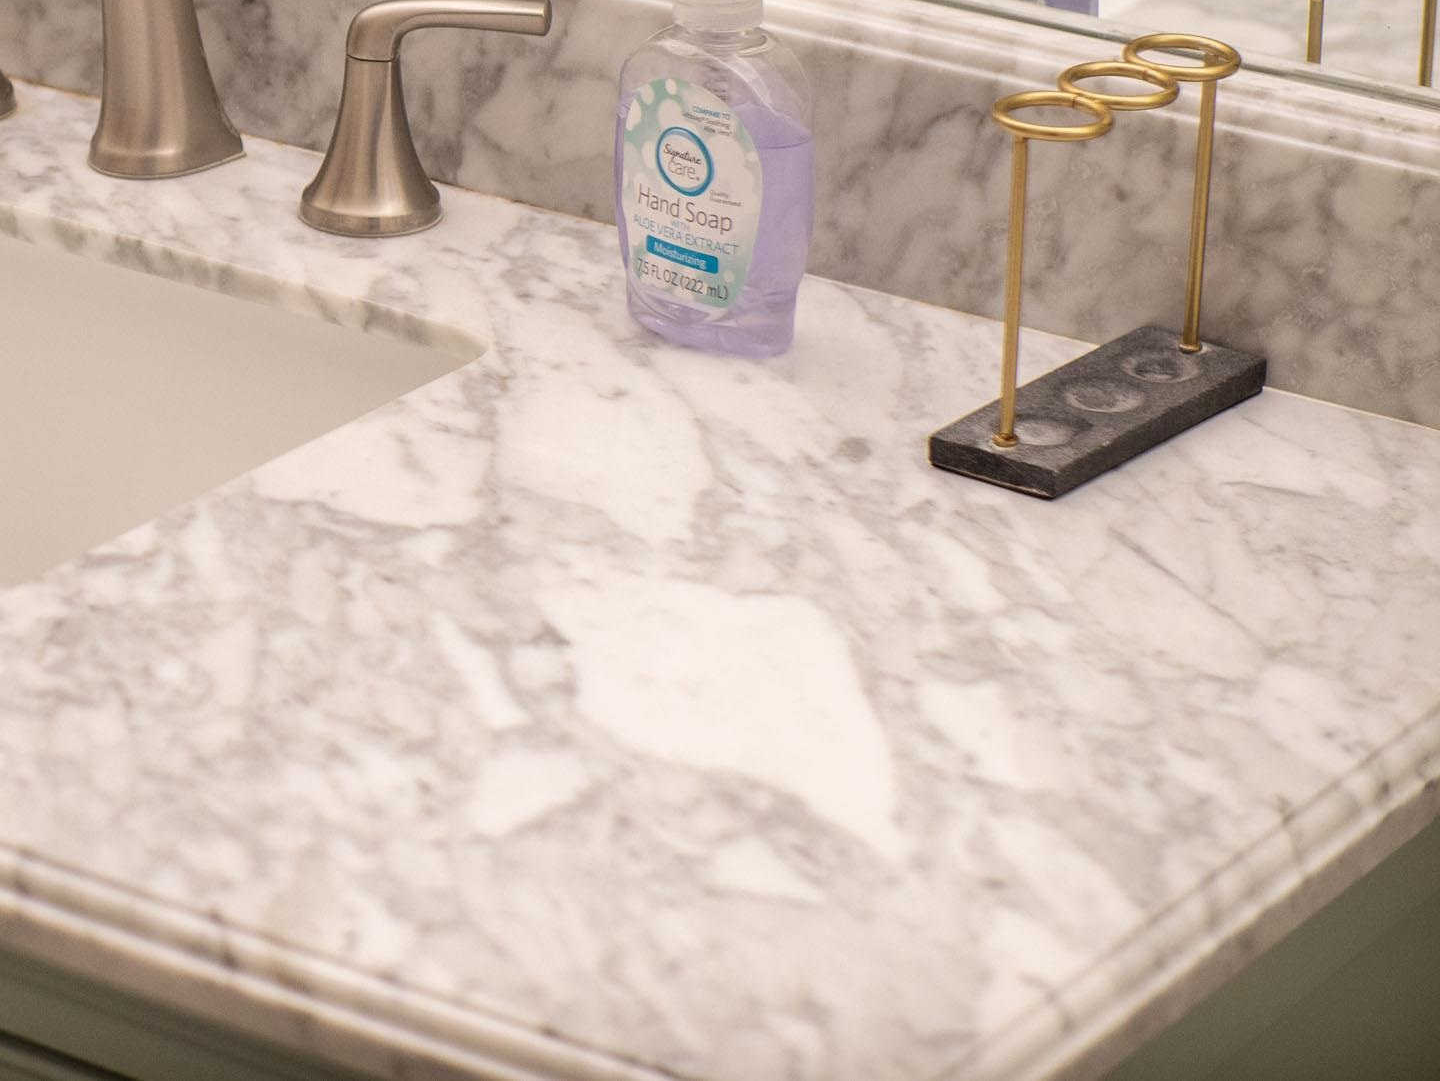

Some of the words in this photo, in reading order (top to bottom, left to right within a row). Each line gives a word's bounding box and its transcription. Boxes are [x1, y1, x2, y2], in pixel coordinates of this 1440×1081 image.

[663, 143, 702, 165] Signature
[638, 183, 680, 218] Hand
[685, 202, 733, 235] Soap
[671, 219, 690, 230] WITH
[633, 214, 656, 232] ALOE
[656, 222, 682, 240] VERA
[685, 233, 739, 255] EXTRACT
[653, 241, 708, 270] Moisturizing
[651, 264, 661, 280] FL
[663, 269, 679, 286] OZ
[680, 275, 704, 294] (222
[706, 284, 729, 301] mL)
